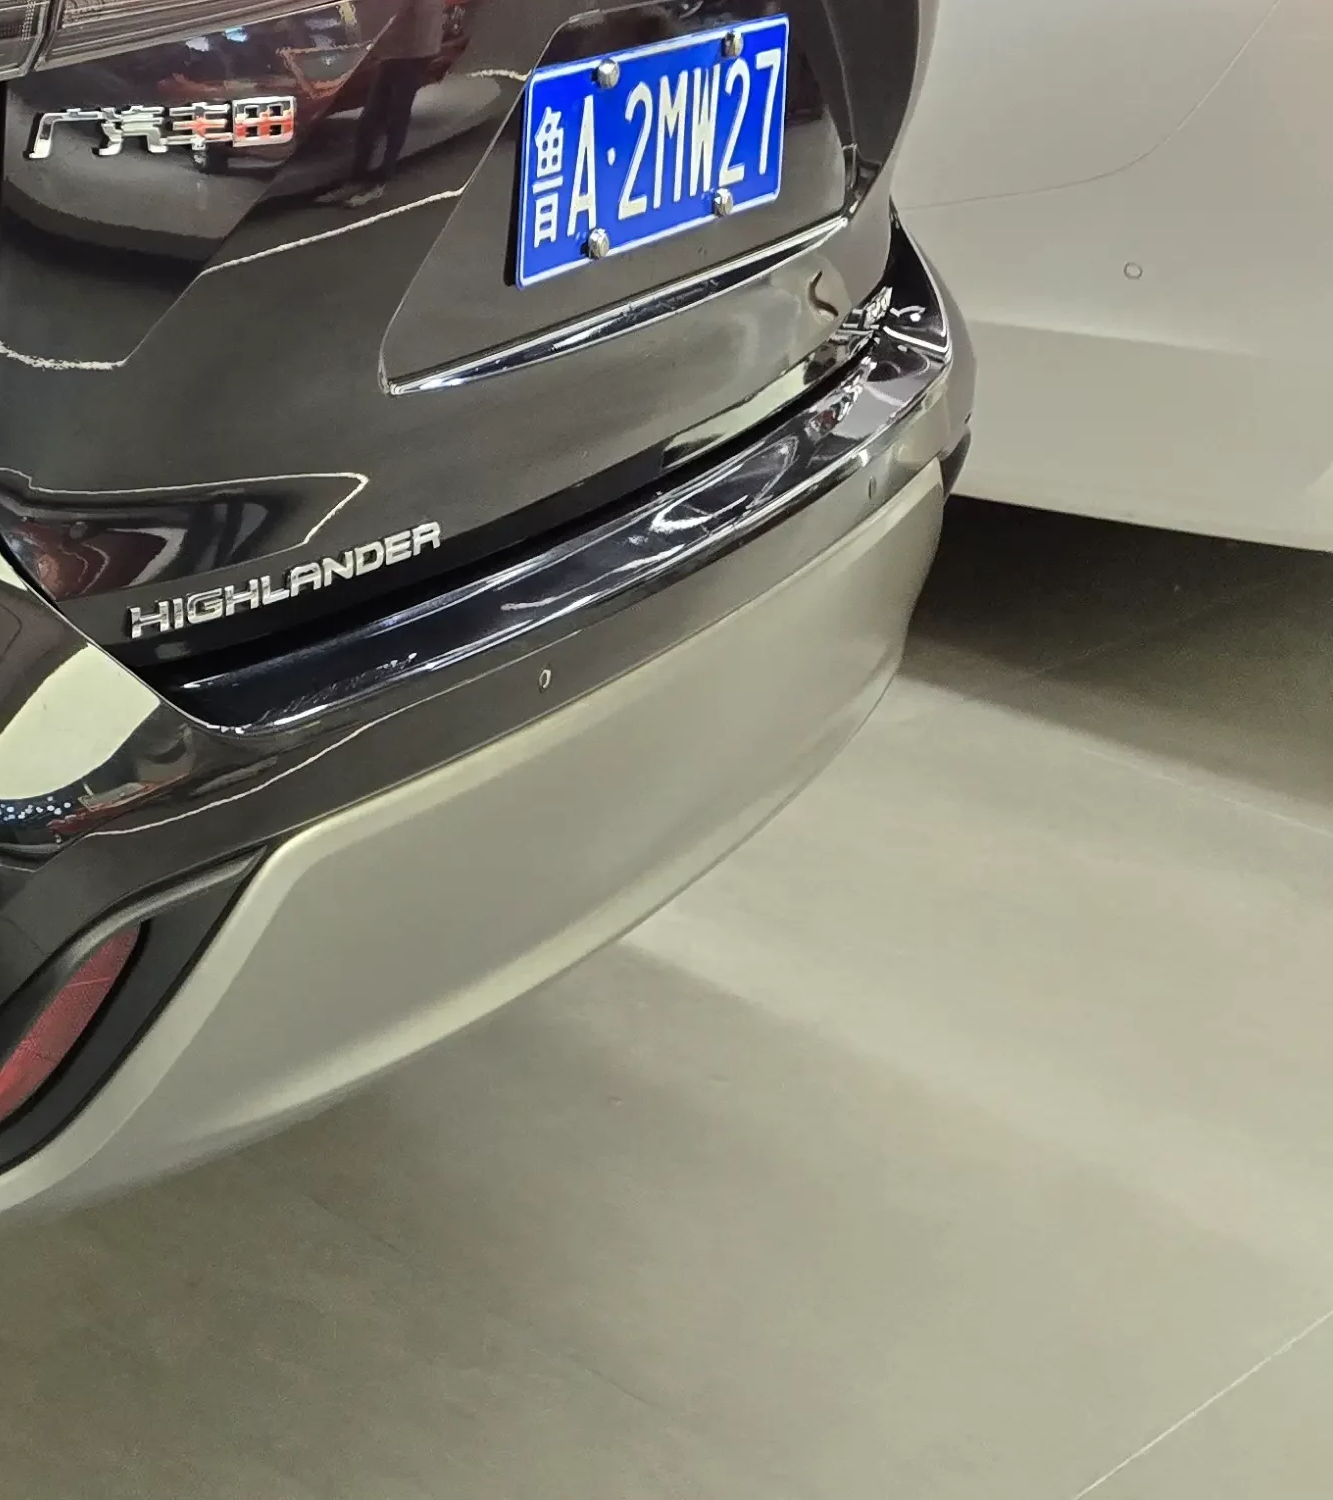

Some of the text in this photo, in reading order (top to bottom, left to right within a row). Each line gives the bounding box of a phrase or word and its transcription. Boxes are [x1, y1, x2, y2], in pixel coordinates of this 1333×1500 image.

[29, 96, 296, 166] 广汽丰田
[129, 520, 441, 638] HIGHLANDER
